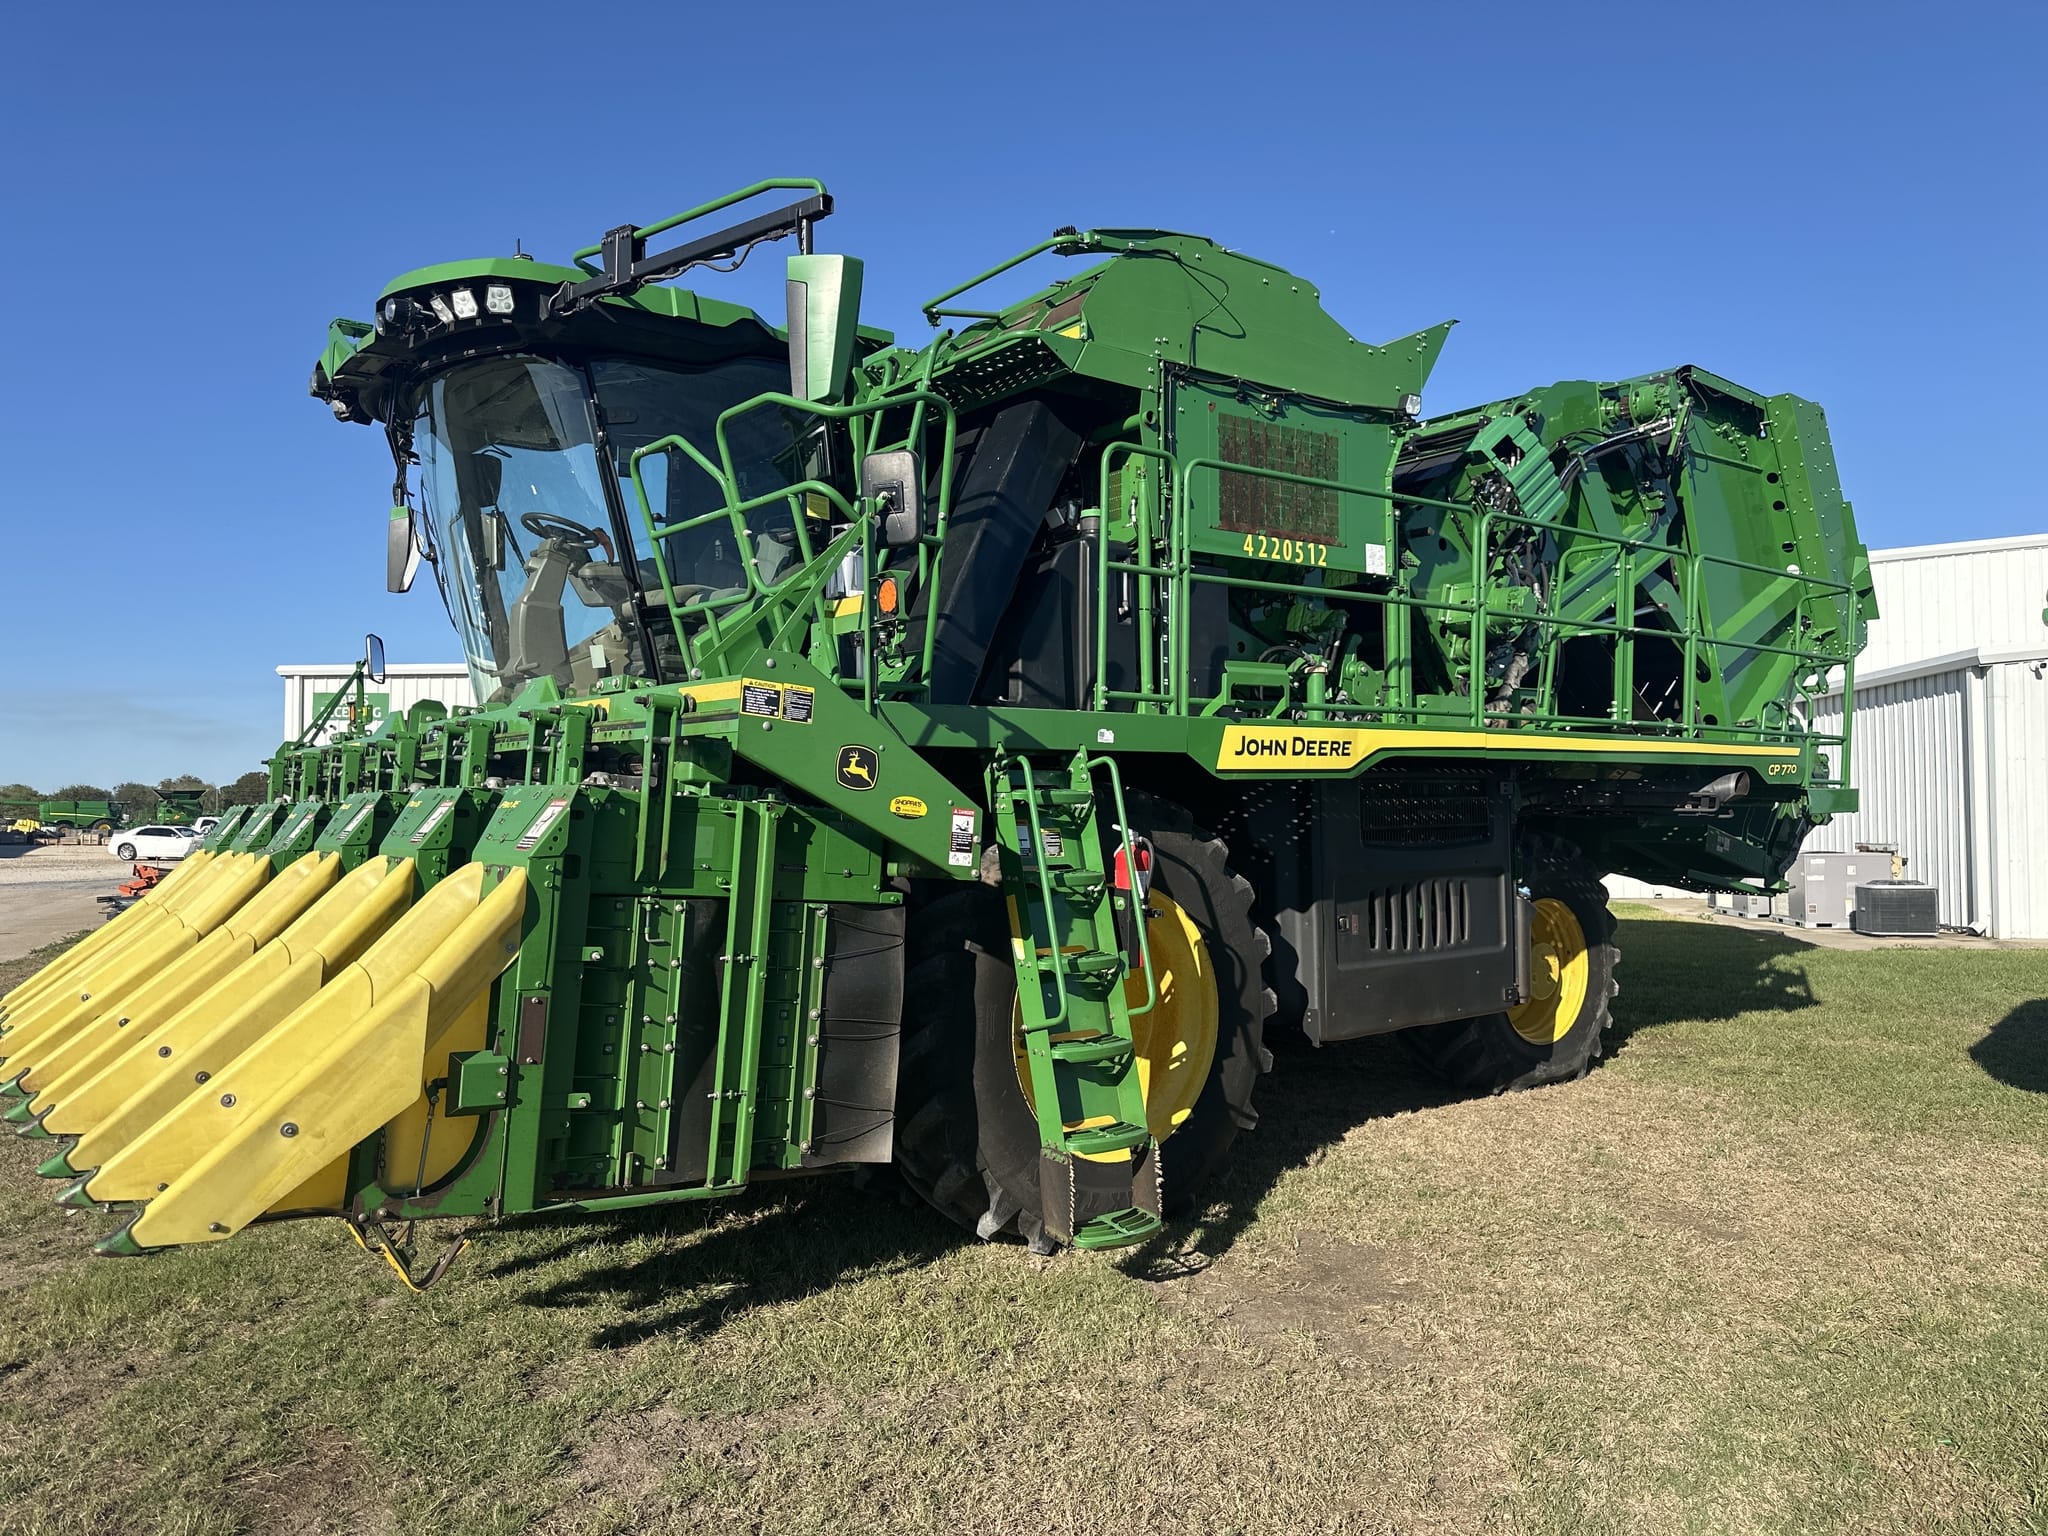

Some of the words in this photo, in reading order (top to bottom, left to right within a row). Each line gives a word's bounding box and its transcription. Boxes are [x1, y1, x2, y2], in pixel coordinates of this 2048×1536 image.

[1243, 534, 1327, 567] 4220512
[754, 681, 777, 689] CAUTION
[1234, 736, 1287, 756] JOHN
[1291, 736, 1352, 757] DEERE
[1768, 764, 1780, 776] CP
[1781, 764, 1797, 776] 770
